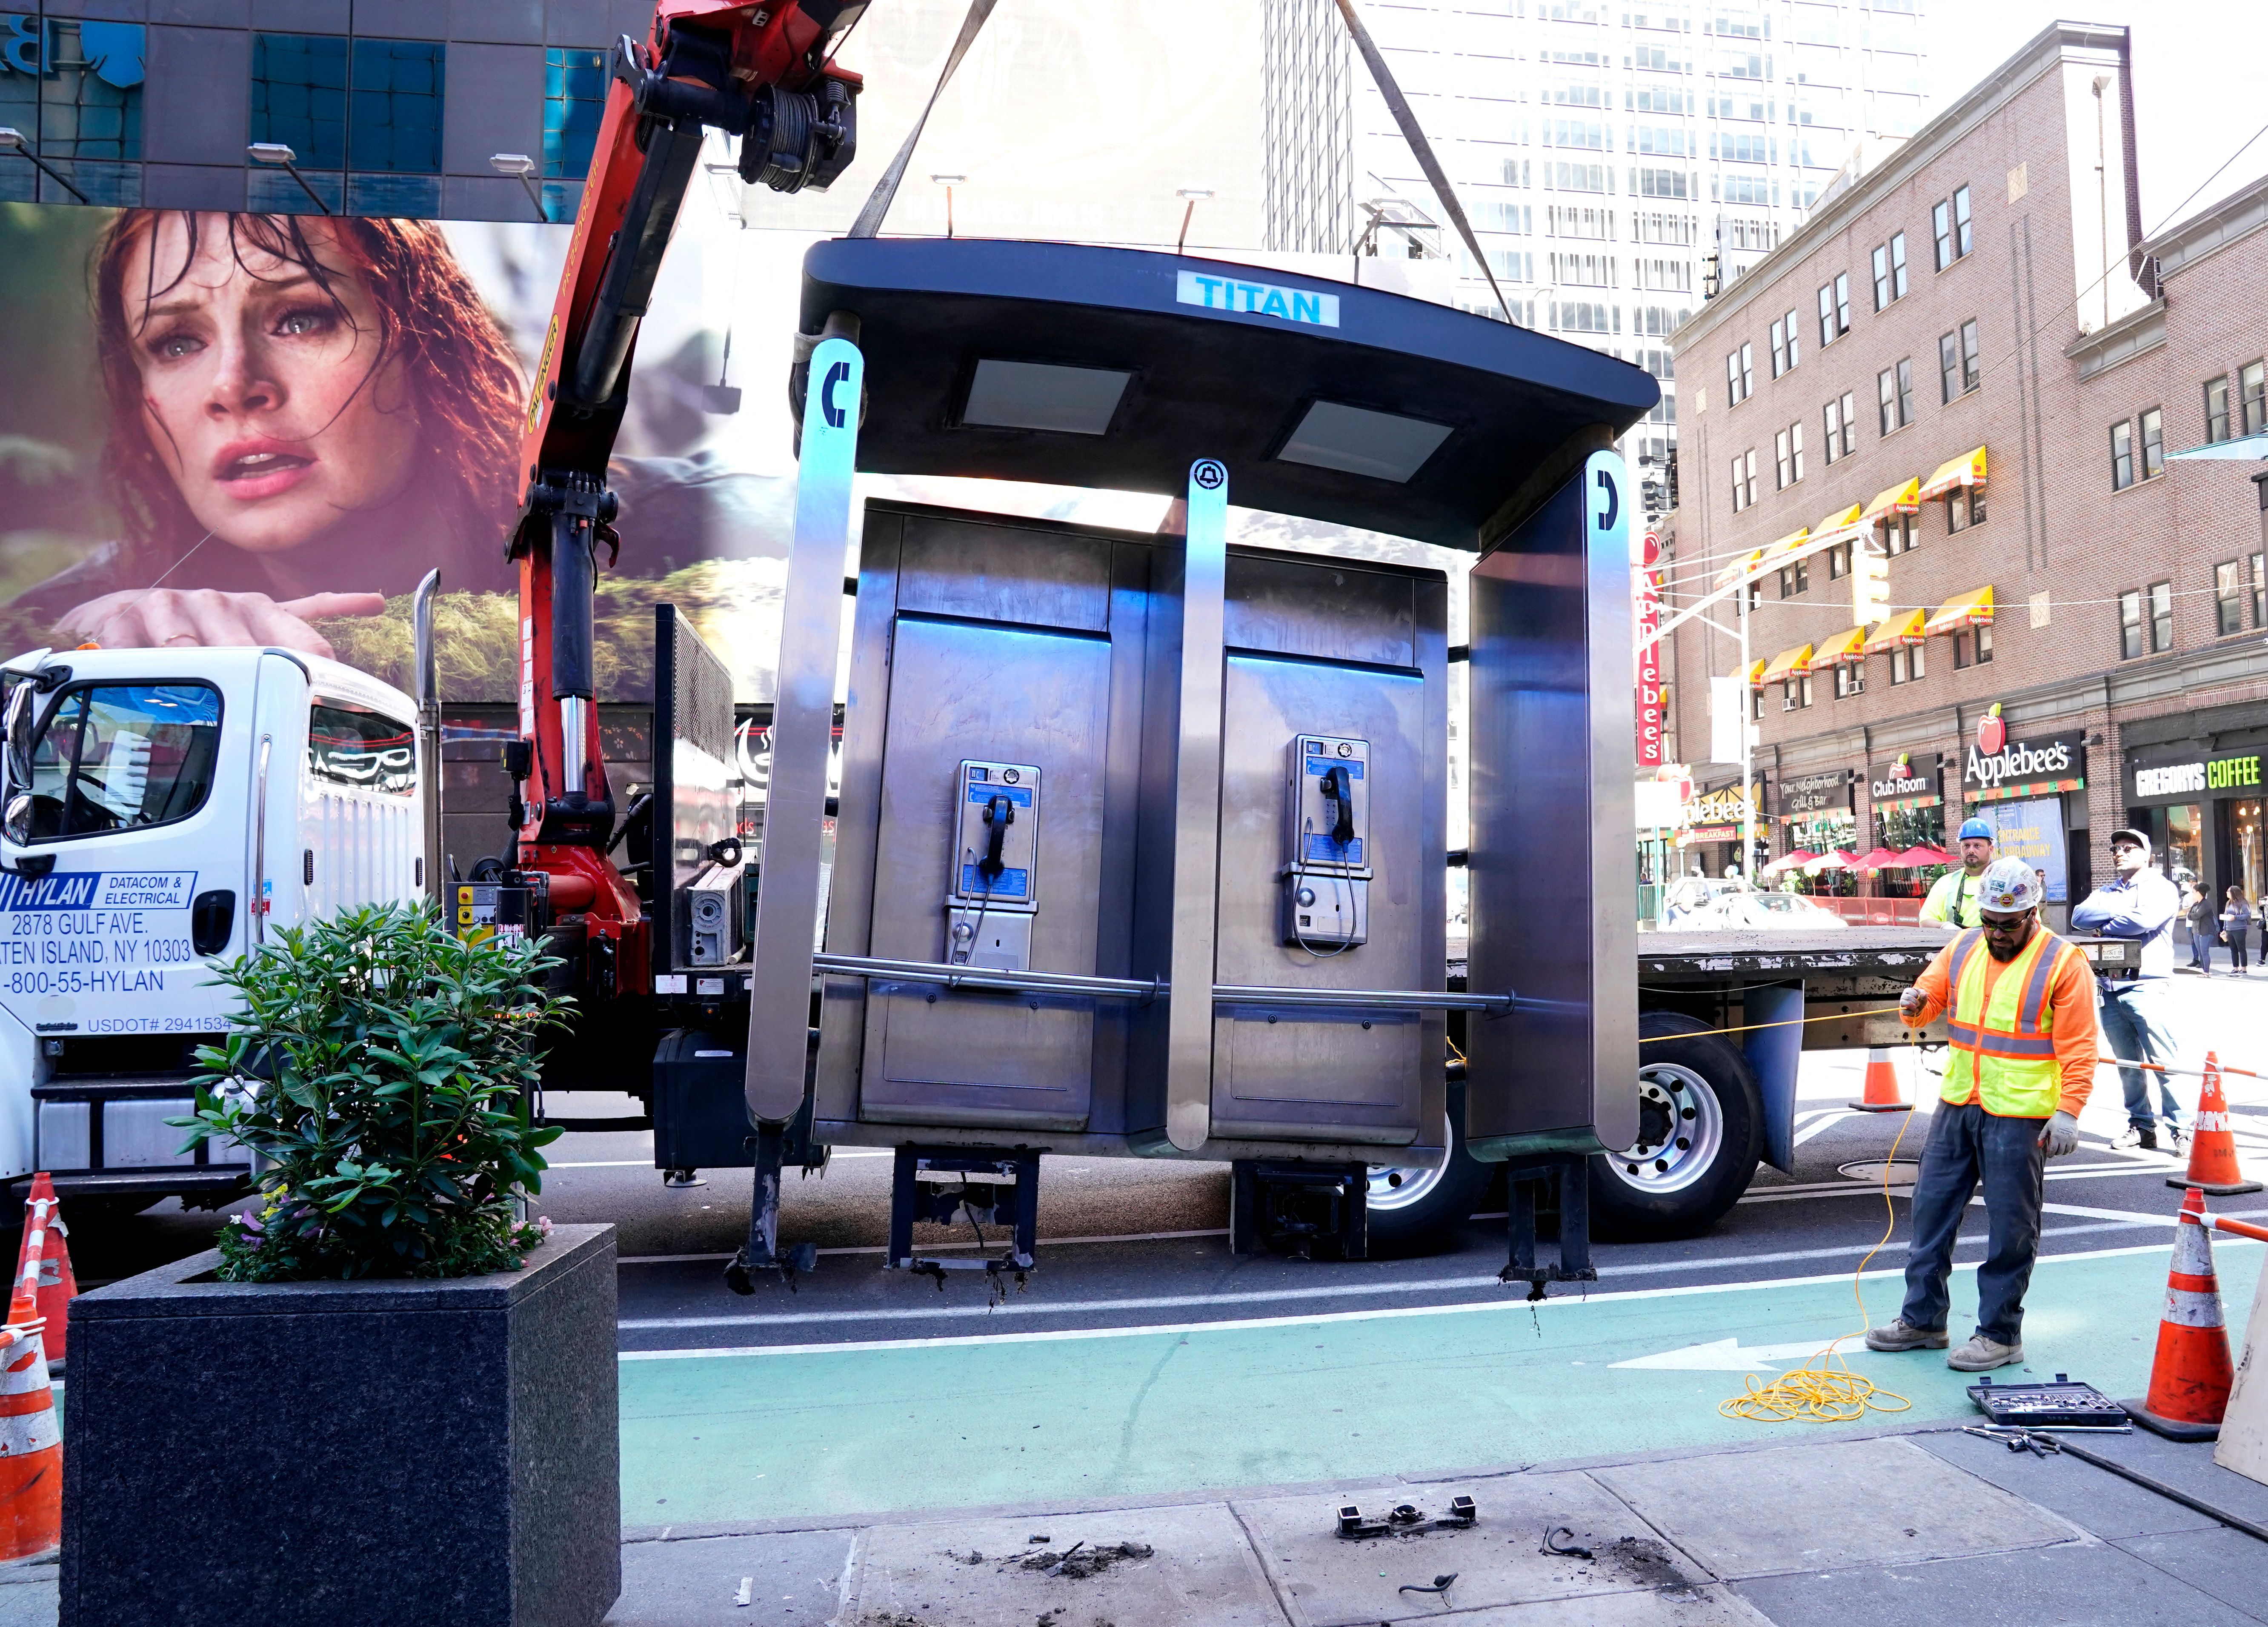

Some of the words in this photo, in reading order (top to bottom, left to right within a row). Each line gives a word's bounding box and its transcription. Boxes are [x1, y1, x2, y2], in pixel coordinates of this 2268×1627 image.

[562, 265, 571, 297] PK
[1195, 277, 1320, 323] TITAN
[529, 325, 558, 428] PALFINGER
[1965, 741, 2069, 789] Applebee's
[2136, 762, 2205, 797] GREGORYS
[2207, 756, 2261, 789] COFFEE
[1780, 782, 1795, 799] Your
[1796, 772, 1839, 794] Neighborhood
[1873, 779, 1894, 797] Club
[1896, 777, 1926, 794] Room
[1813, 795, 1827, 806] Bar
[1695, 830, 1734, 839] BREAKFAST
[1998, 827, 2041, 843] ENTRANCE
[2004, 843, 2051, 859] BROADWAY
[17, 877, 93, 905] HYLAN
[109, 877, 169, 889] DATACOM
[174, 876, 182, 888] &
[105, 892, 180, 905] ELECTRICAL
[12, 914, 52, 935] 2878
[59, 913, 106, 935] GULF
[109, 913, 149, 934] AVE.
[0, 942, 35, 965] TEN
[42, 940, 108, 965] ISLAND,
[114, 939, 137, 962] NY
[144, 939, 190, 962] 10303
[88, 1018, 160, 1033] USDOT#
[165, 1017, 232, 1031] 2941534
